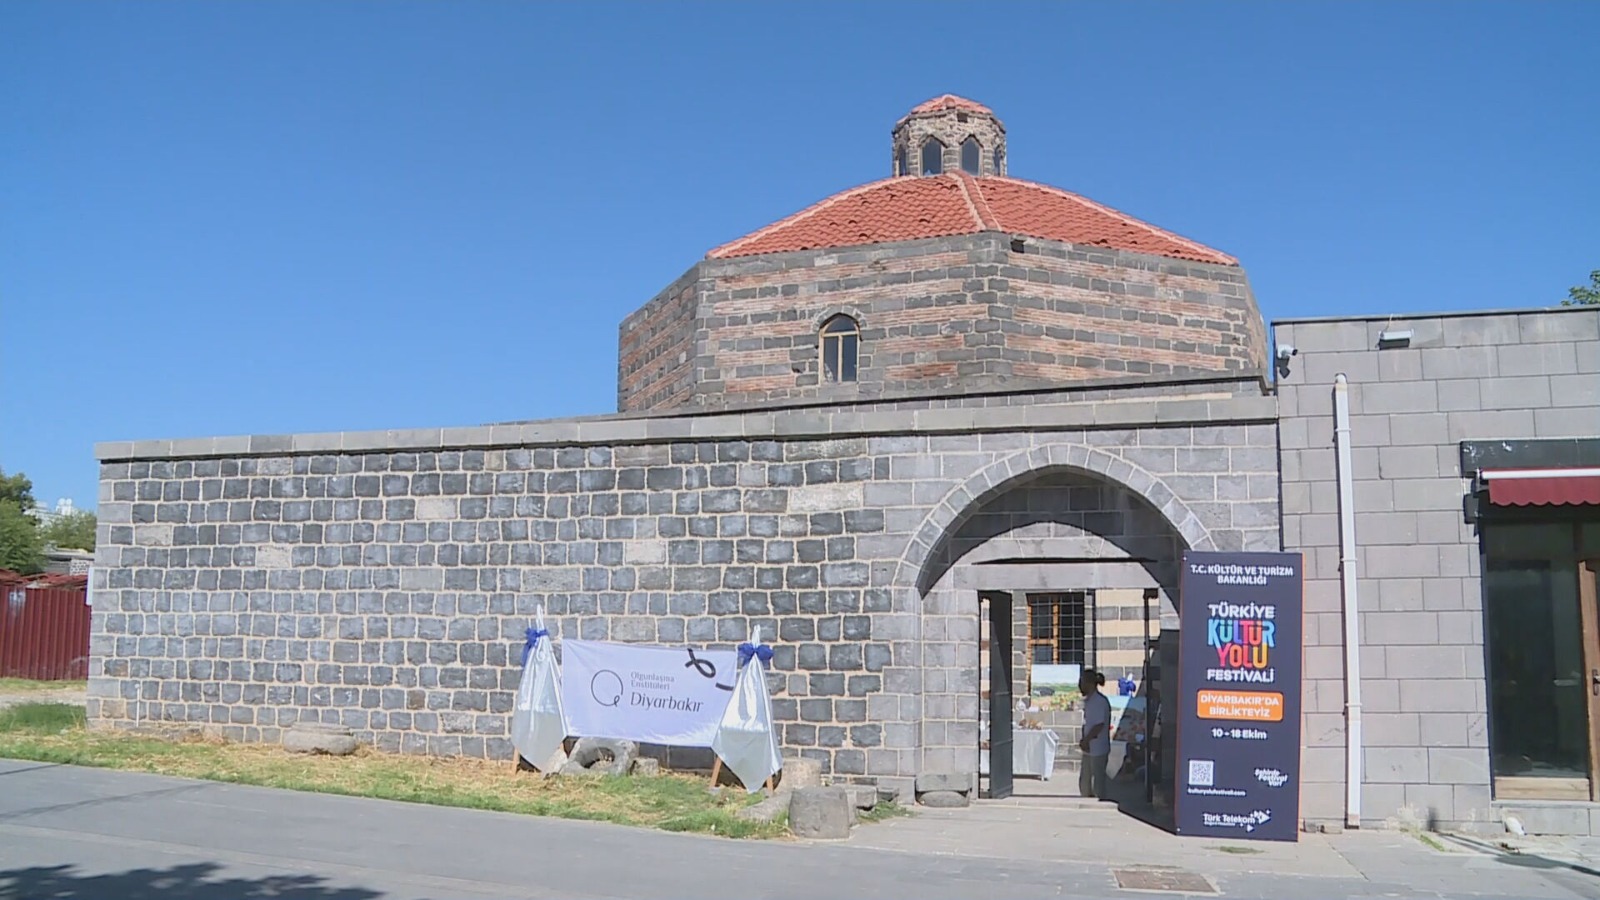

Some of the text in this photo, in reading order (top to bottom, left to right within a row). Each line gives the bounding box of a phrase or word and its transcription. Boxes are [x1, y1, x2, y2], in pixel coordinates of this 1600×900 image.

[1208, 564, 1244, 575] KÜLTÜR
[1245, 566, 1257, 575] VE
[1258, 565, 1294, 576] TURİZM
[1217, 575, 1267, 585] BAKANLIĞI
[1208, 602, 1275, 619] TÜRKİYE
[1208, 618, 1275, 648] KÜLTÜR
[1216, 642, 1268, 669] YOLU
[1207, 667, 1274, 682] FESTİVALİ
[631, 679, 670, 690] Enstitüleri
[630, 691, 704, 712] Diyarbakır
[1200, 693, 1280, 706] DİYARBAKIR'DA
[1209, 705, 1271, 717] BİRLİKTEYİZ
[1211, 728, 1223, 738] 10
[1230, 729, 1241, 739] 18
[1242, 729, 1267, 740] Ekim
[1203, 813, 1221, 822] Türk
[1222, 814, 1256, 824] Telekom
